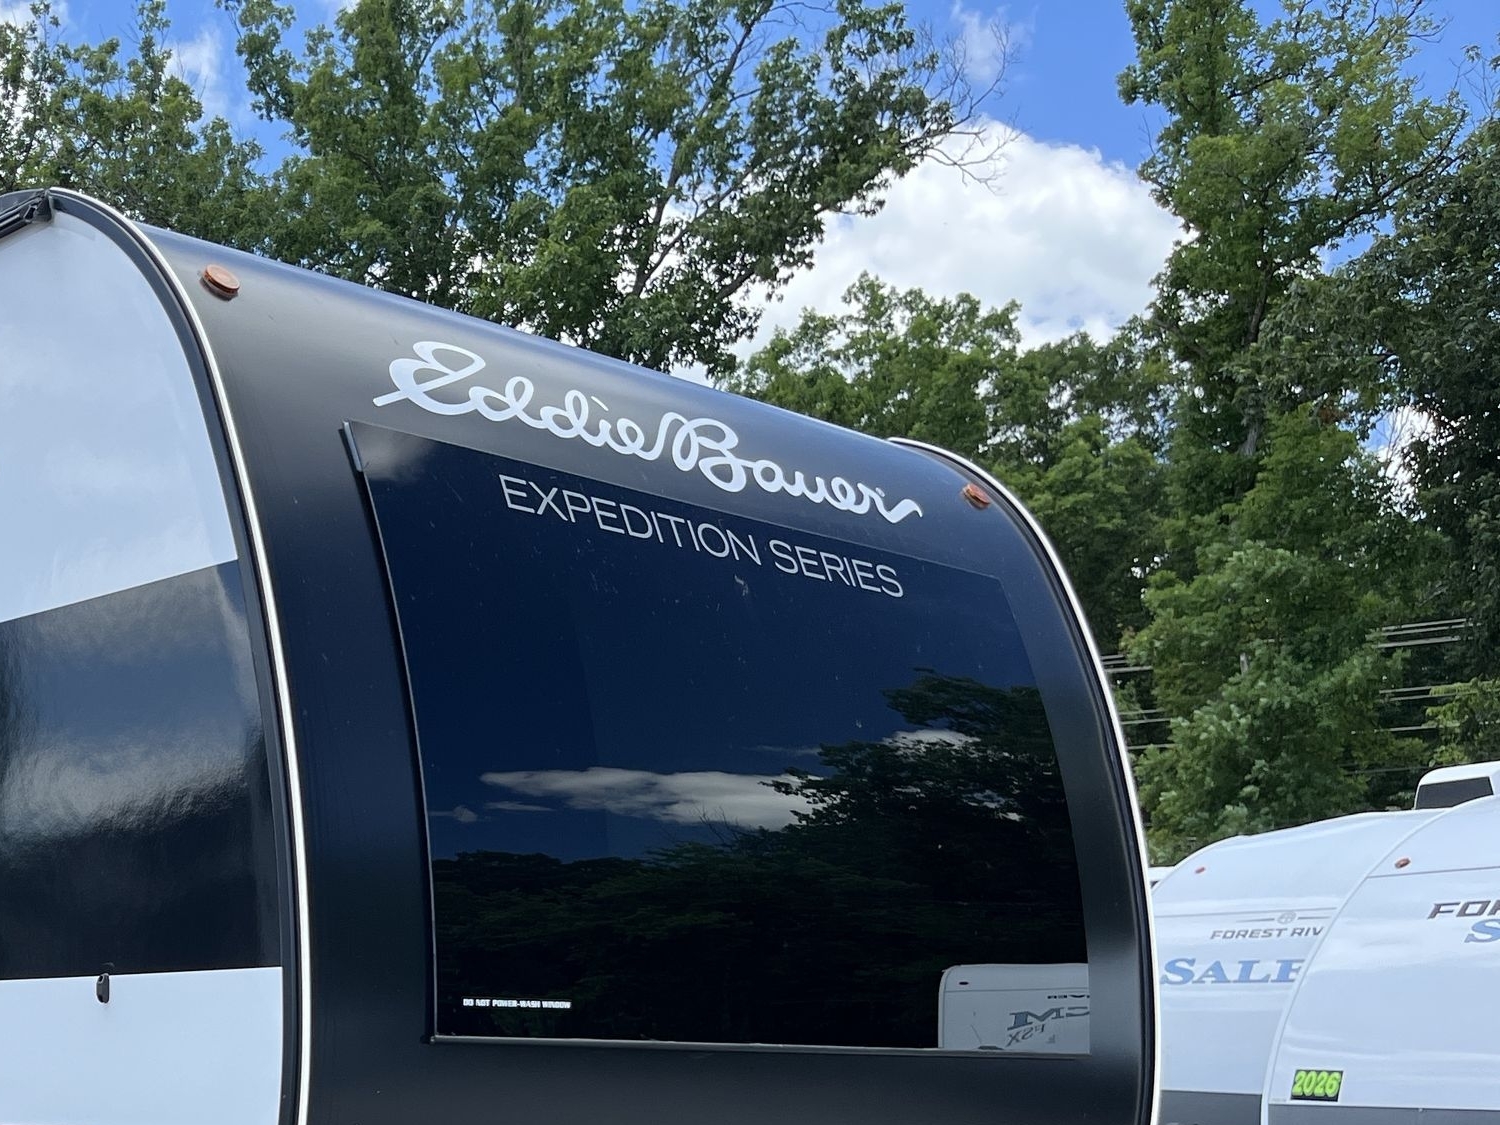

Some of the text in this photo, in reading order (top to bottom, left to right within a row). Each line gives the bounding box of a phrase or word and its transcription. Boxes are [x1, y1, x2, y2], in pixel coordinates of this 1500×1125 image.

[373, 341, 924, 524] Eddie Bauer
[499, 474, 904, 598] EXPEDITION SERIES
[1210, 927, 1324, 940] FOREST RIV
[462, 998, 474, 1007] DO
[475, 999, 490, 1007] NOT
[542, 1001, 572, 1009] WINDOW
[1292, 1070, 1341, 1098] 2026
